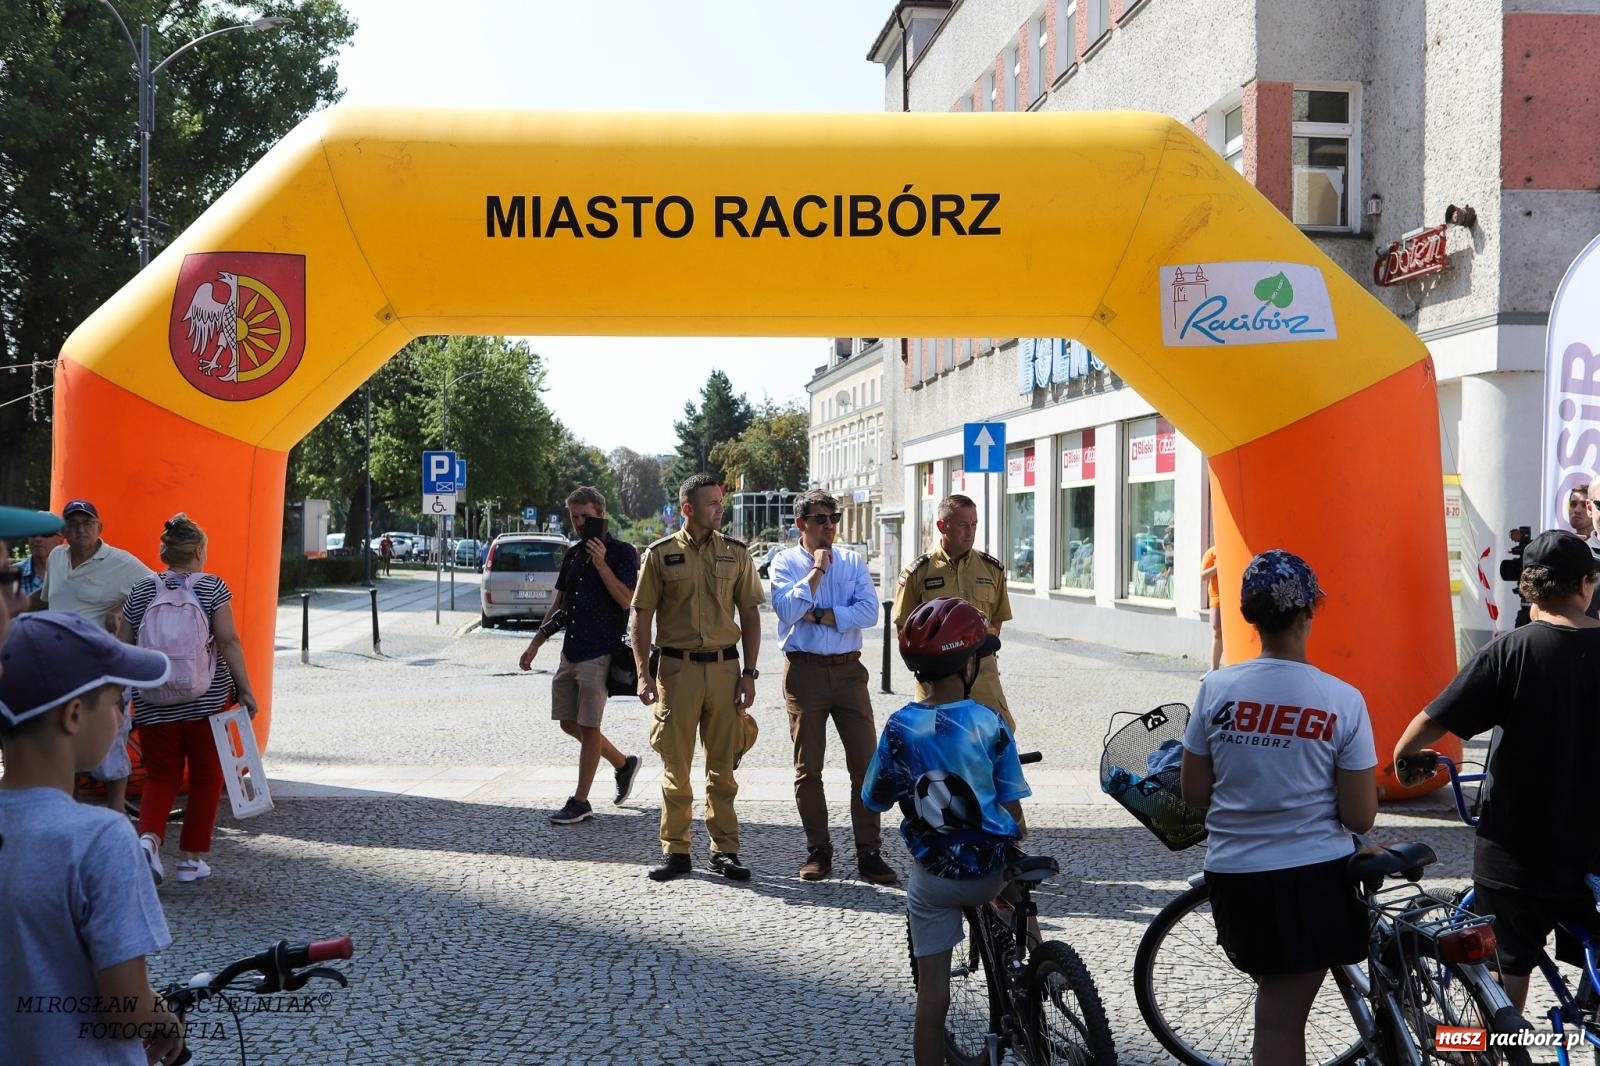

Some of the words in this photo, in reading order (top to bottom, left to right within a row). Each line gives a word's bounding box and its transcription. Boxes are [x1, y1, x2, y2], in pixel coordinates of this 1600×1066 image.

[485, 194, 696, 239] MIASTO
[713, 183, 1002, 239] RACIBÓRZ
[1179, 294, 1326, 345] Racibórz
[430, 455, 450, 482] P
[526, 507, 535, 519] P
[1219, 733, 1292, 749] RACIBÓRZ
